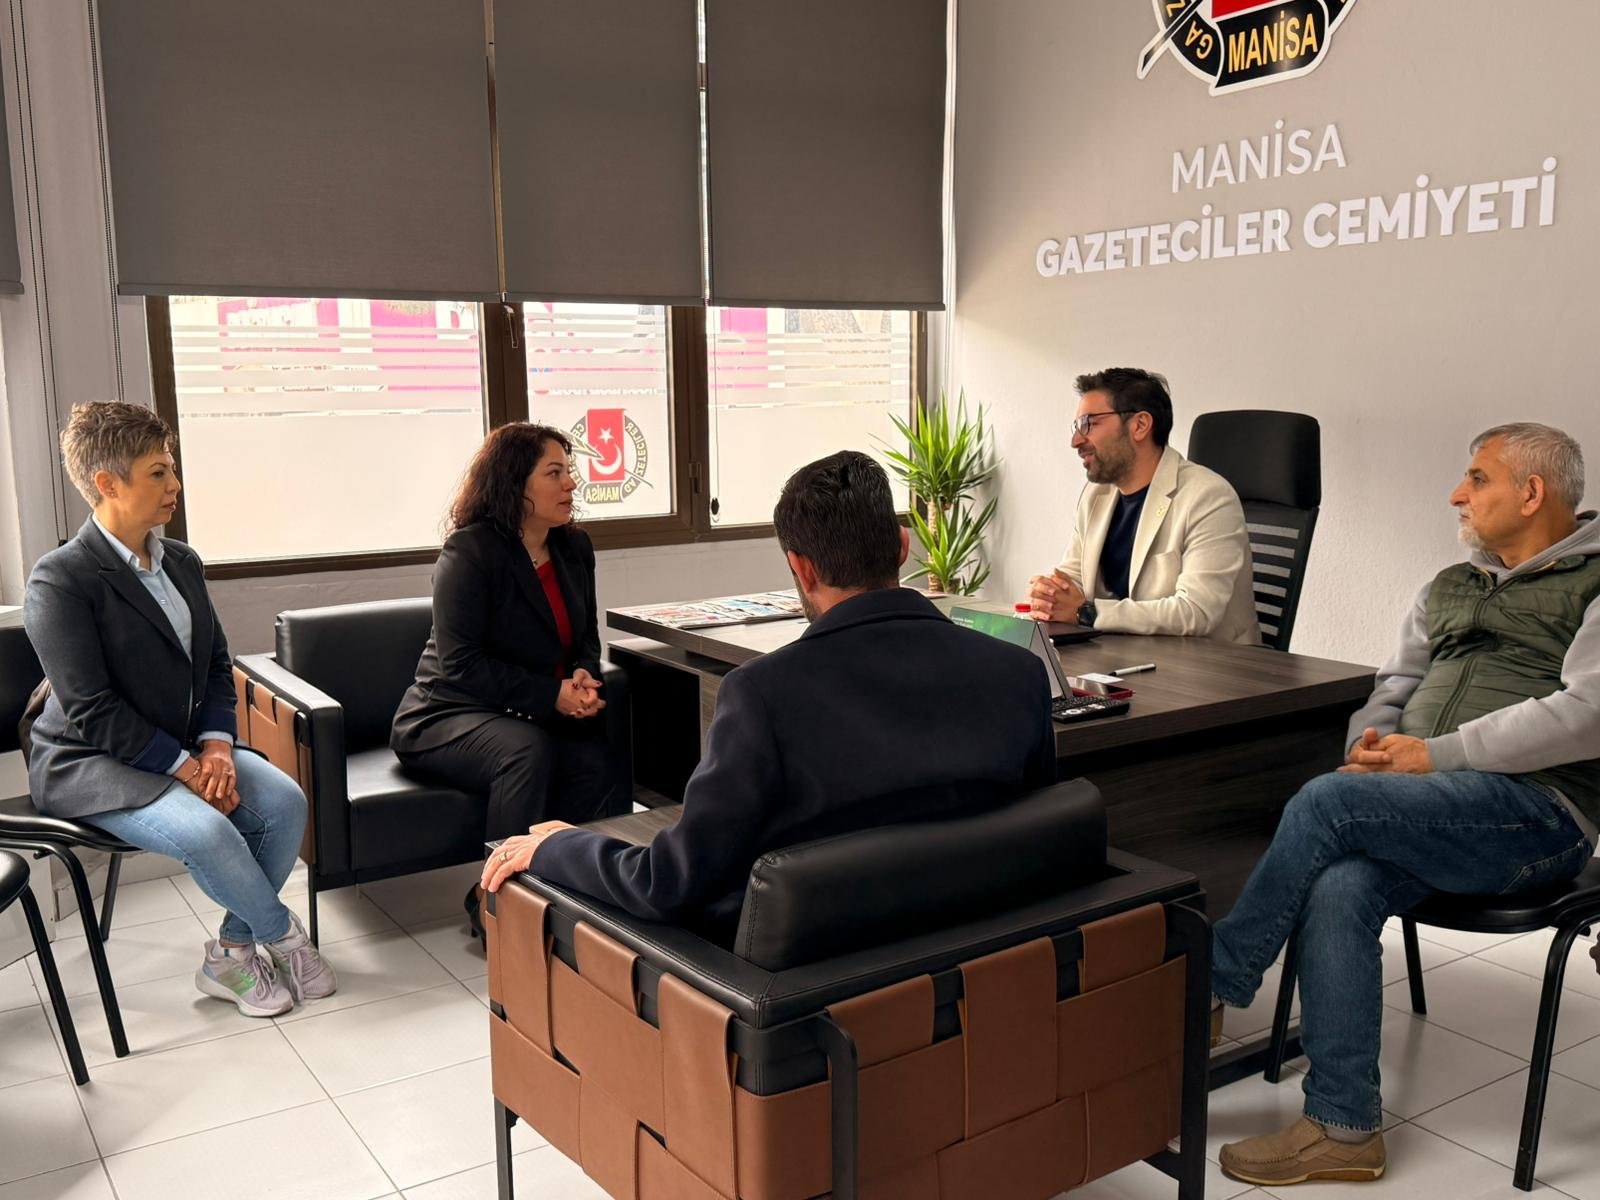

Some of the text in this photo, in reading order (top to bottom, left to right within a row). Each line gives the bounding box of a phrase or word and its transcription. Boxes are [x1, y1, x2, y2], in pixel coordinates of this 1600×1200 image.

[1228, 10, 1318, 73] MANİSA
[1171, 118, 1348, 194] MANİSA
[1036, 156, 1559, 278] GAZETECİLER CEMİYETİ
